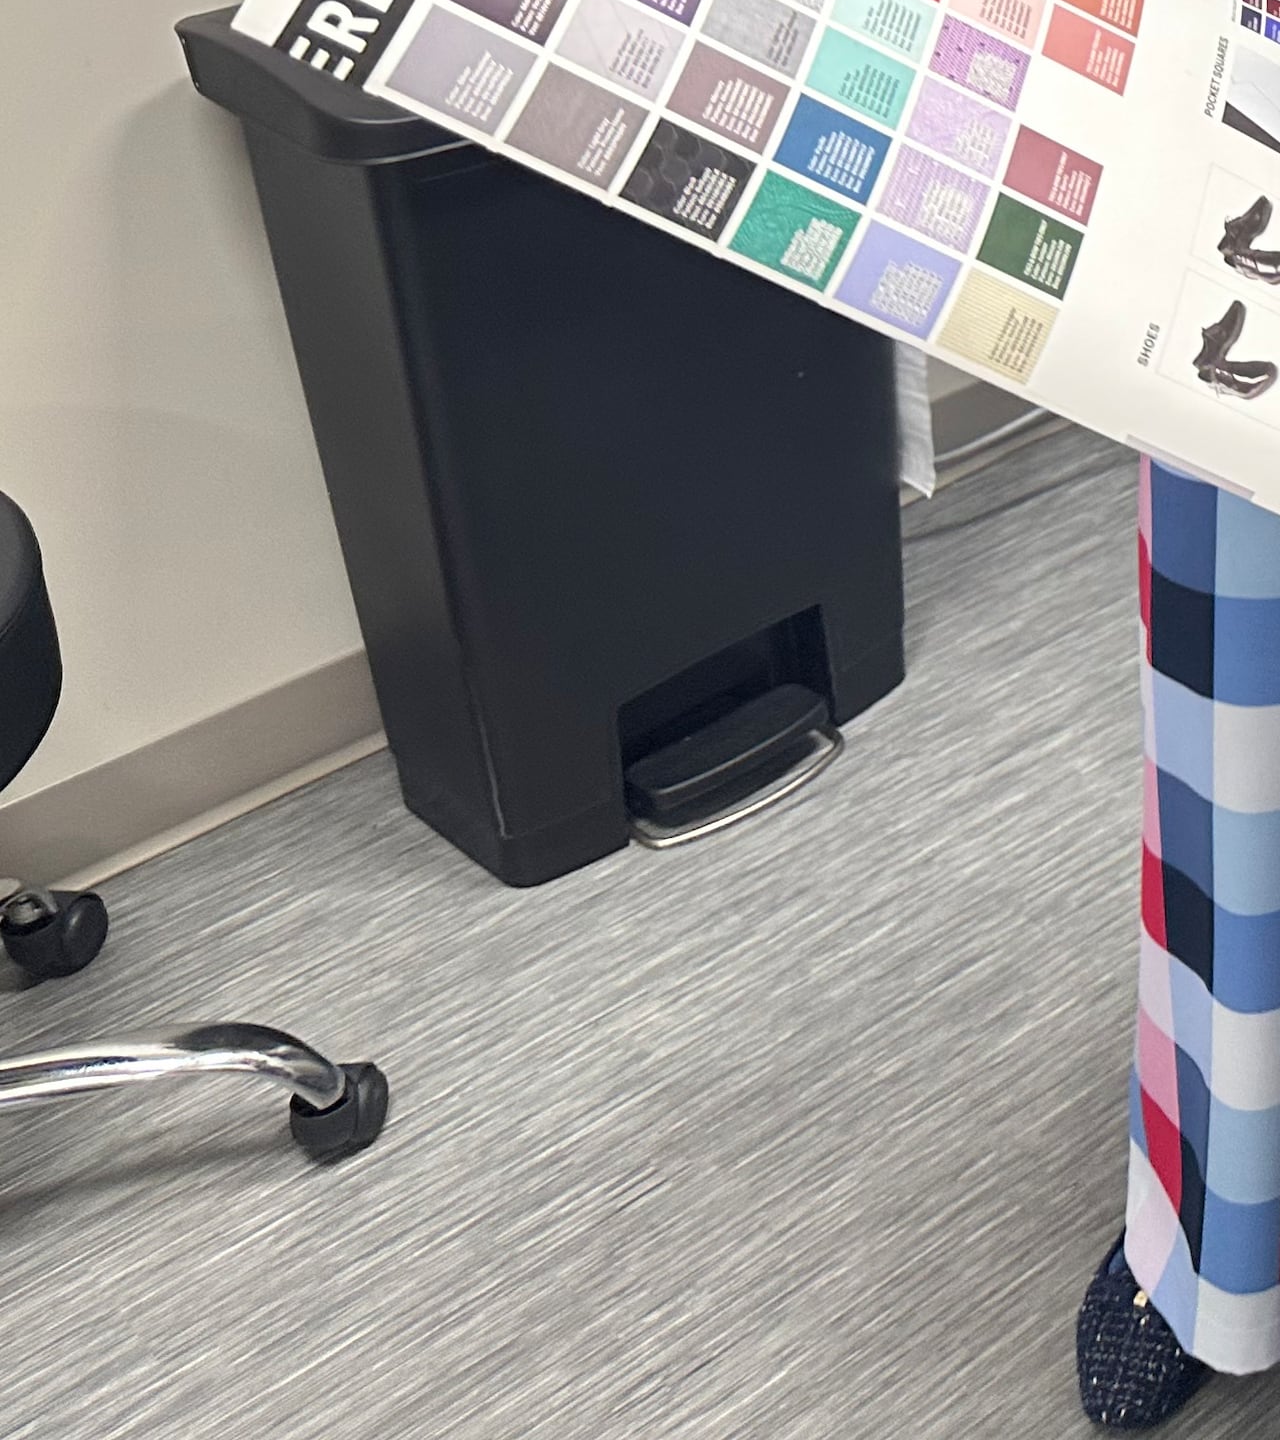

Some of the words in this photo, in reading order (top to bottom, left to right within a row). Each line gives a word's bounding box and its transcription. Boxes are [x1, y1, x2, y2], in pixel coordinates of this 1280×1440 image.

[1210, 34, 1230, 79] SQUARES
[1203, 75, 1222, 118] POCKET
[1136, 321, 1160, 367] SHOES
